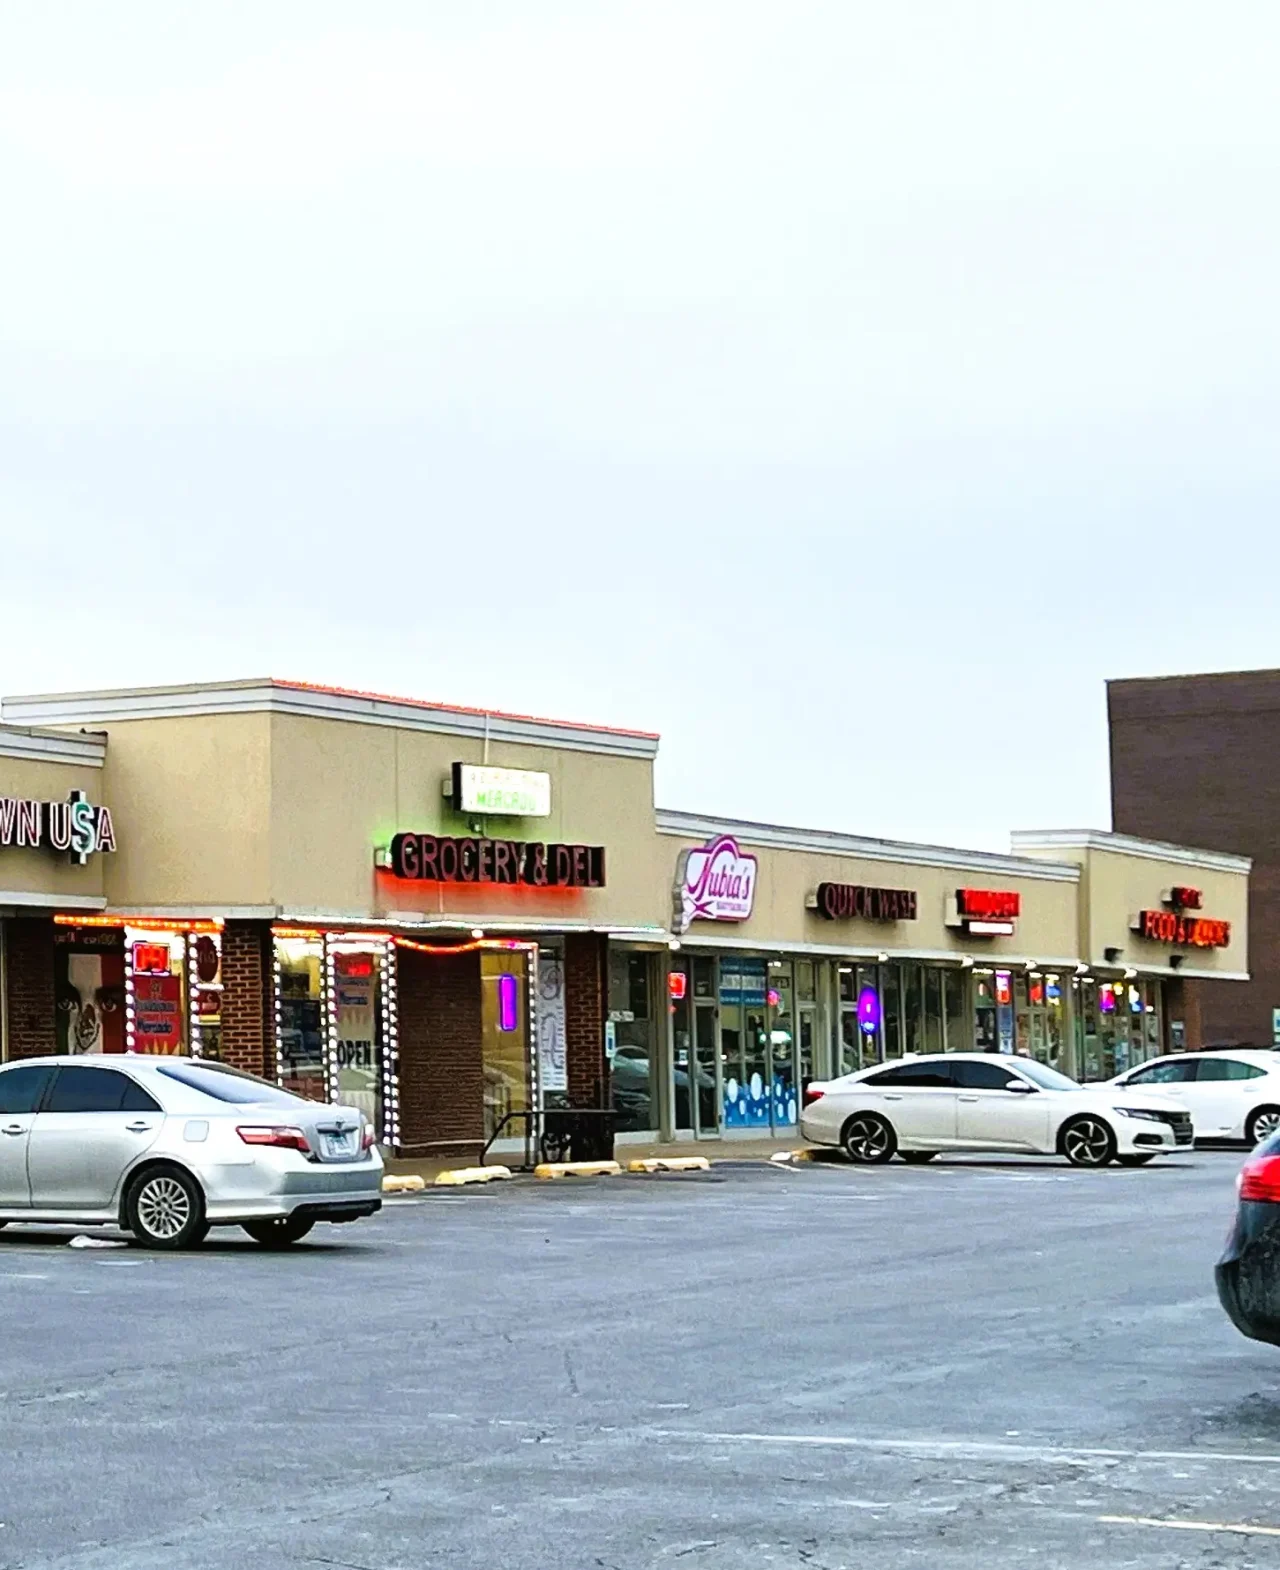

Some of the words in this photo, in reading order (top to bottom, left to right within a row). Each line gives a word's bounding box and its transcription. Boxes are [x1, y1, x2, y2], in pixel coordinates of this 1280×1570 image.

[400, 834, 527, 884] GROCERY
[533, 843, 549, 886] &
[824, 884, 872, 919] QUICK
